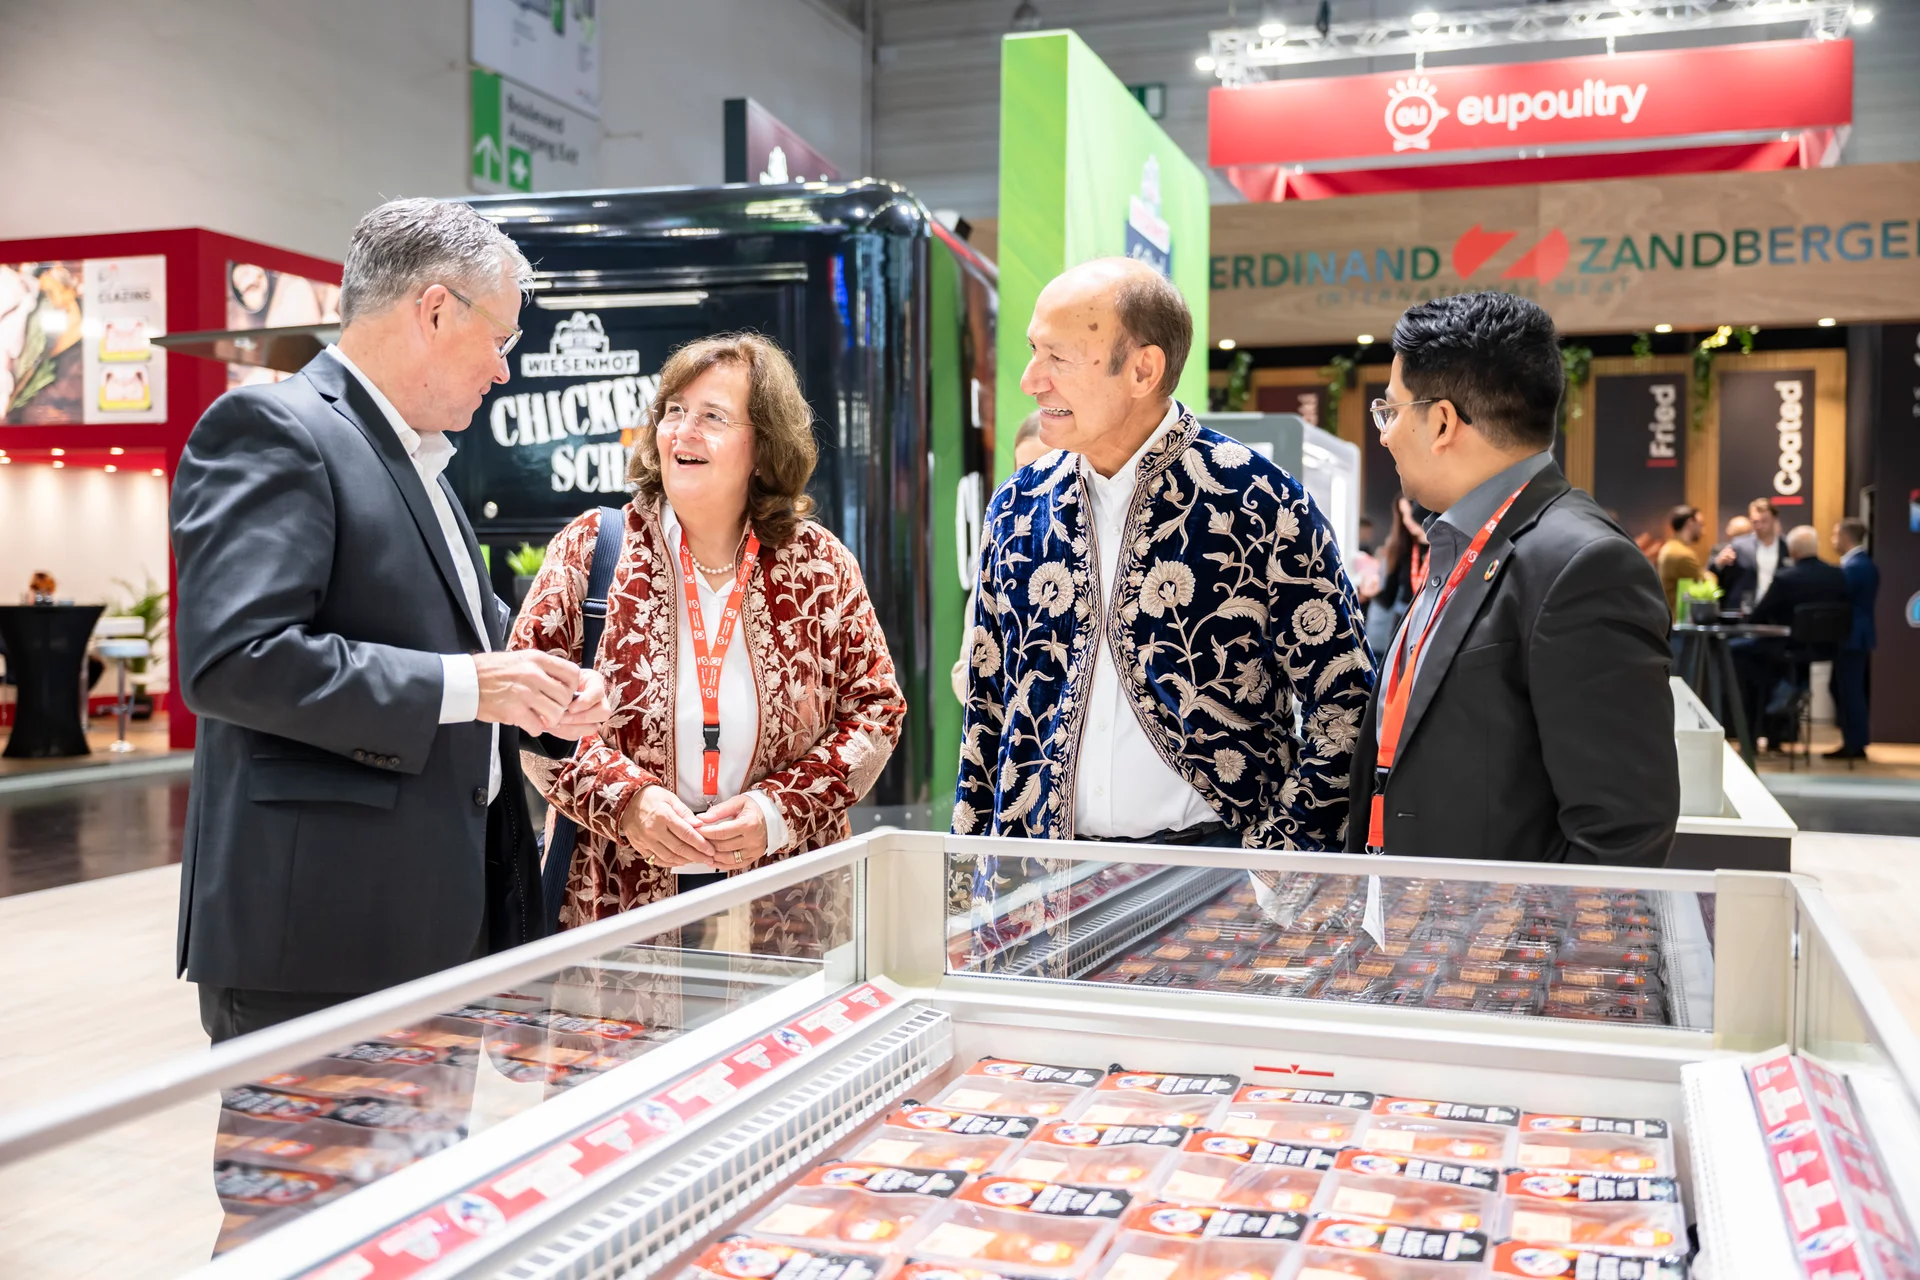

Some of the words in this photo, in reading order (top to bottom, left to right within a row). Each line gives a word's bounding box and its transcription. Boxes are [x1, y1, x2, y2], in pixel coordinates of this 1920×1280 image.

[1394, 104, 1429, 128] eu
[1456, 78, 1648, 132] eupoultry
[1209, 245, 1441, 290] ERDINAND
[1554, 275, 1630, 297] MEAT
[528, 355, 634, 374] WIESENHOF
[1648, 383, 1677, 458] Fried
[1772, 379, 1804, 496] Coated
[551, 442, 637, 493] SCH
